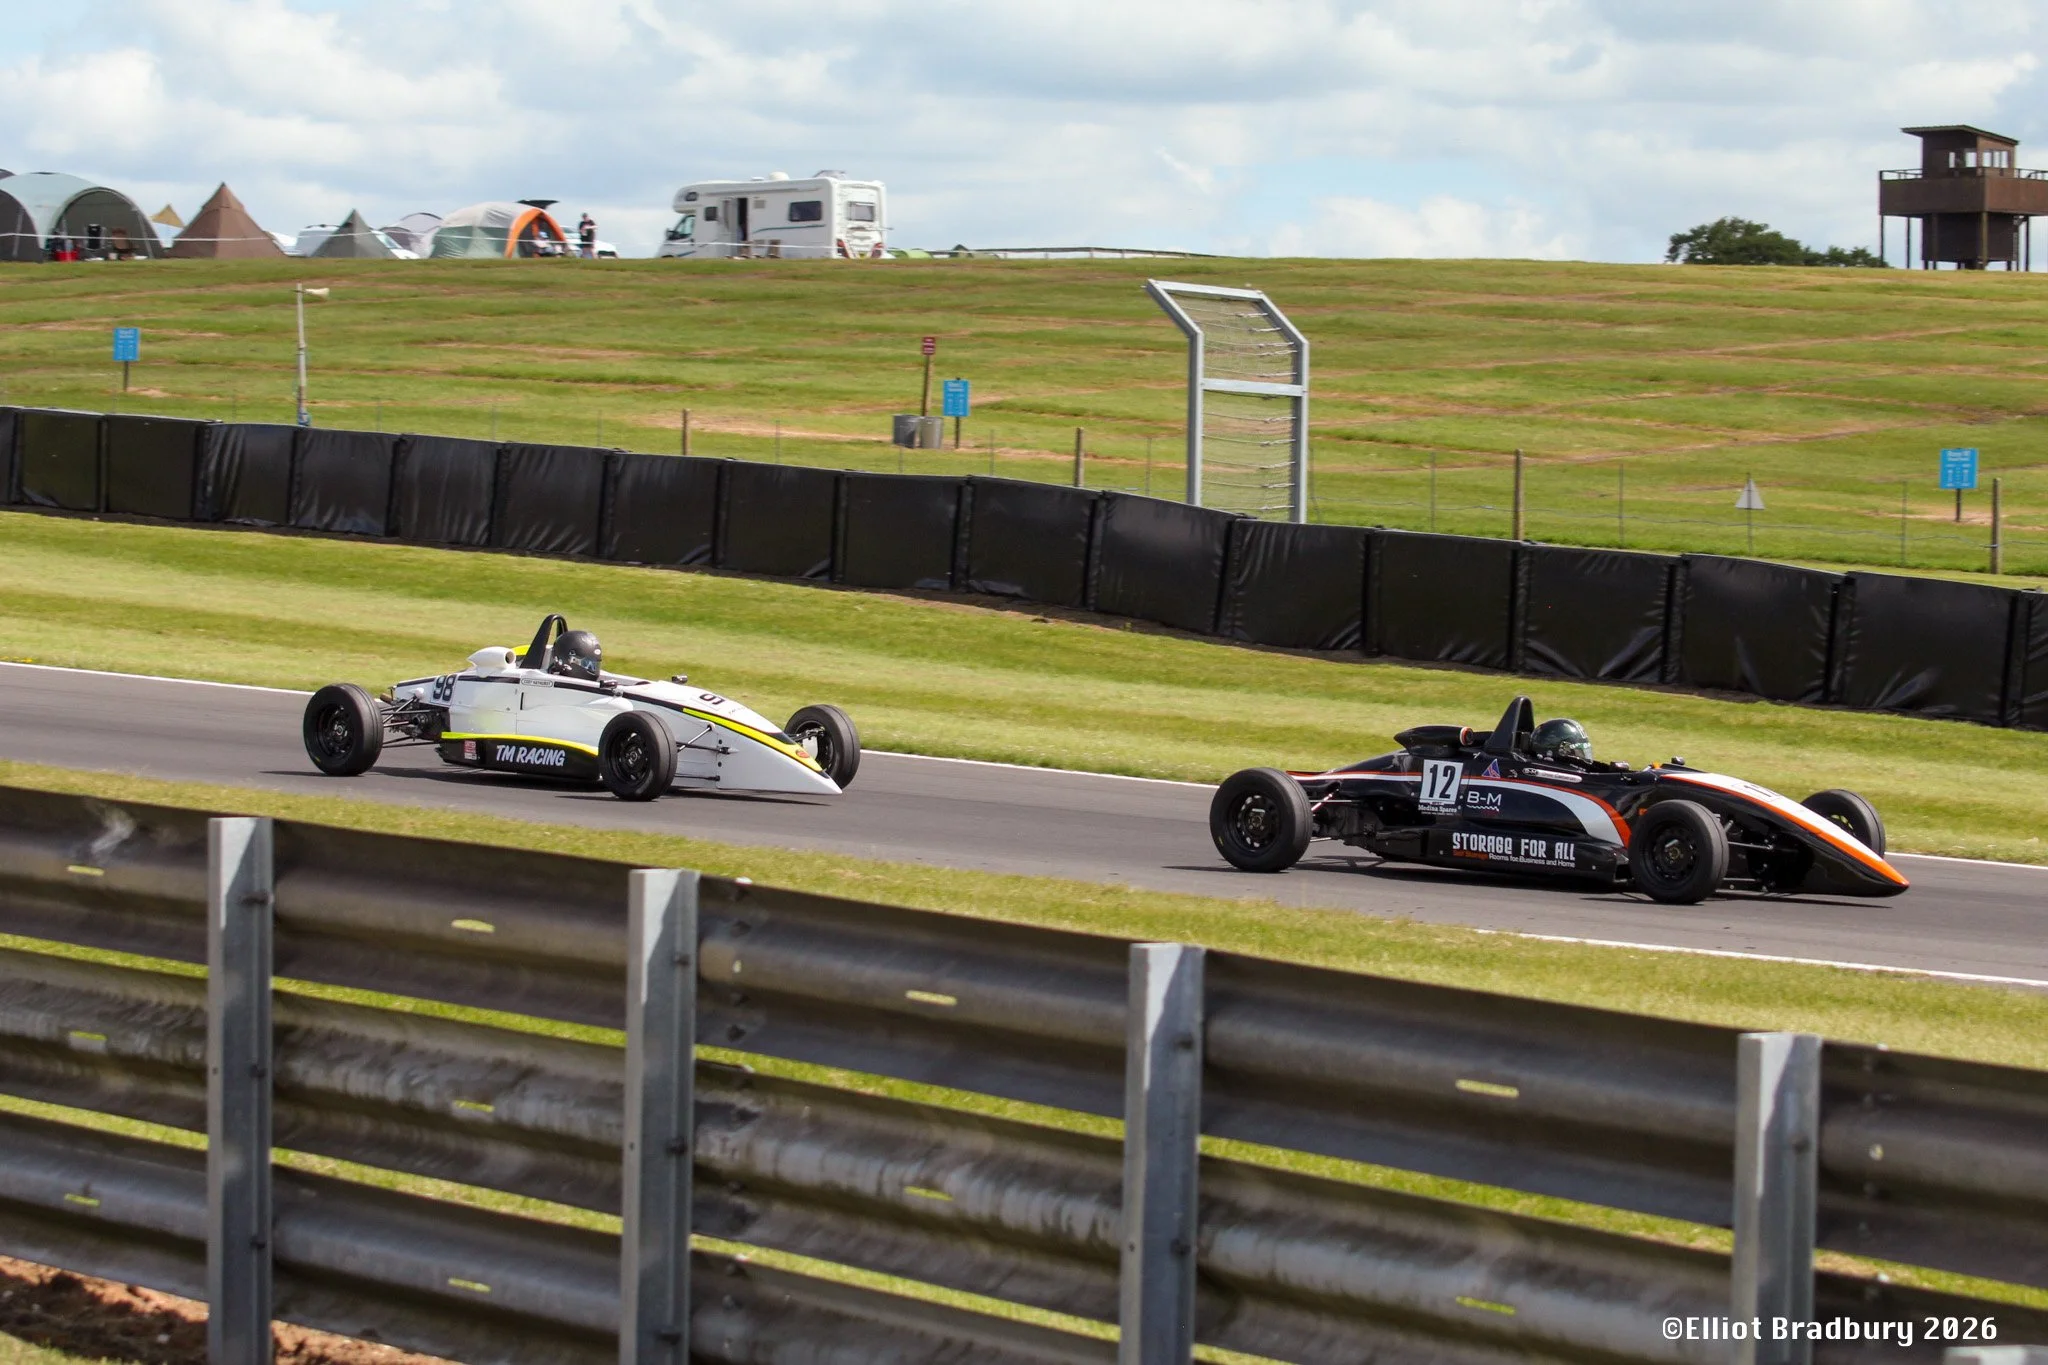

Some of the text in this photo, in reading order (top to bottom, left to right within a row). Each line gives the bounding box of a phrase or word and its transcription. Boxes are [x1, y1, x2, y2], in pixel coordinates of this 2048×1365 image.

[433, 675, 457, 701] 98
[496, 745, 515, 762] TM
[516, 747, 565, 766] RACING
[1429, 764, 1456, 799] 12
[1418, 804, 1438, 812] Medina
[1439, 805, 1458, 814] Spares
[1467, 791, 1502, 806] B-M
[1452, 832, 1576, 861] STORAGE FOR ALL
[1489, 852, 1509, 861] Rooms
[1520, 855, 1546, 866] Business
[1558, 860, 1576, 868] Home
